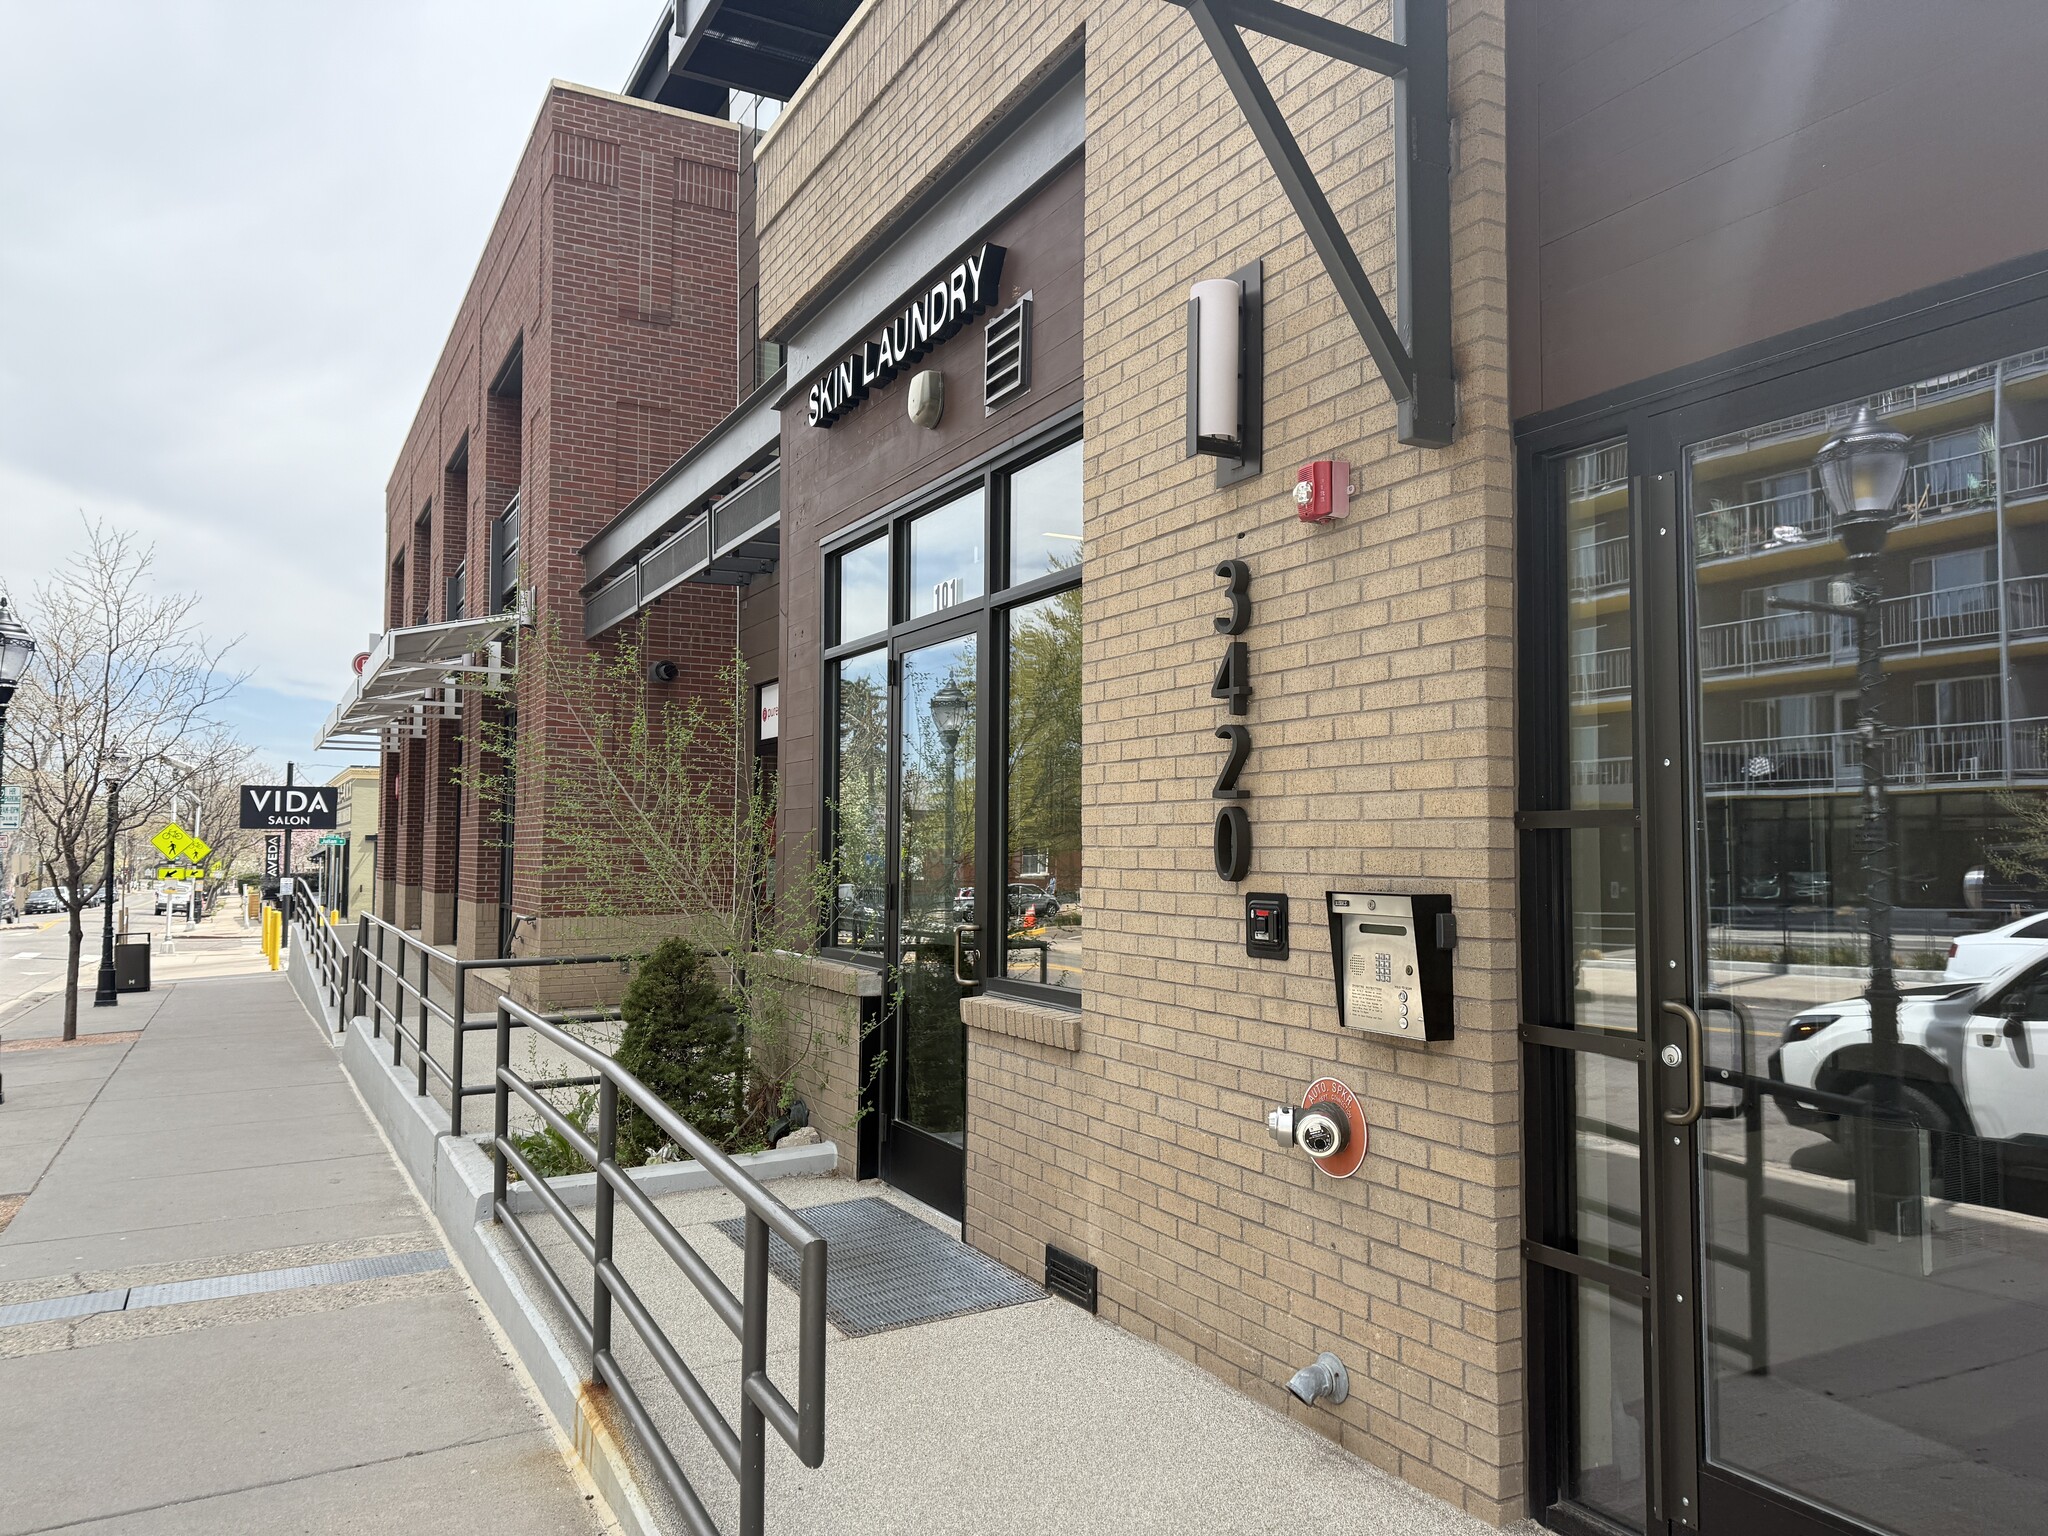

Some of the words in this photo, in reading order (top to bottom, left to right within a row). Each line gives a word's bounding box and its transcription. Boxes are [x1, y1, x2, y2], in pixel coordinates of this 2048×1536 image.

[808, 353, 854, 428] SKIN
[862, 241, 991, 388] LAUNDRY
[934, 578, 957, 612] 101
[1211, 559, 1252, 882] 3420
[249, 790, 329, 813] VIDA
[267, 815, 311, 825] SALON
[267, 836, 278, 877] AVEDA
